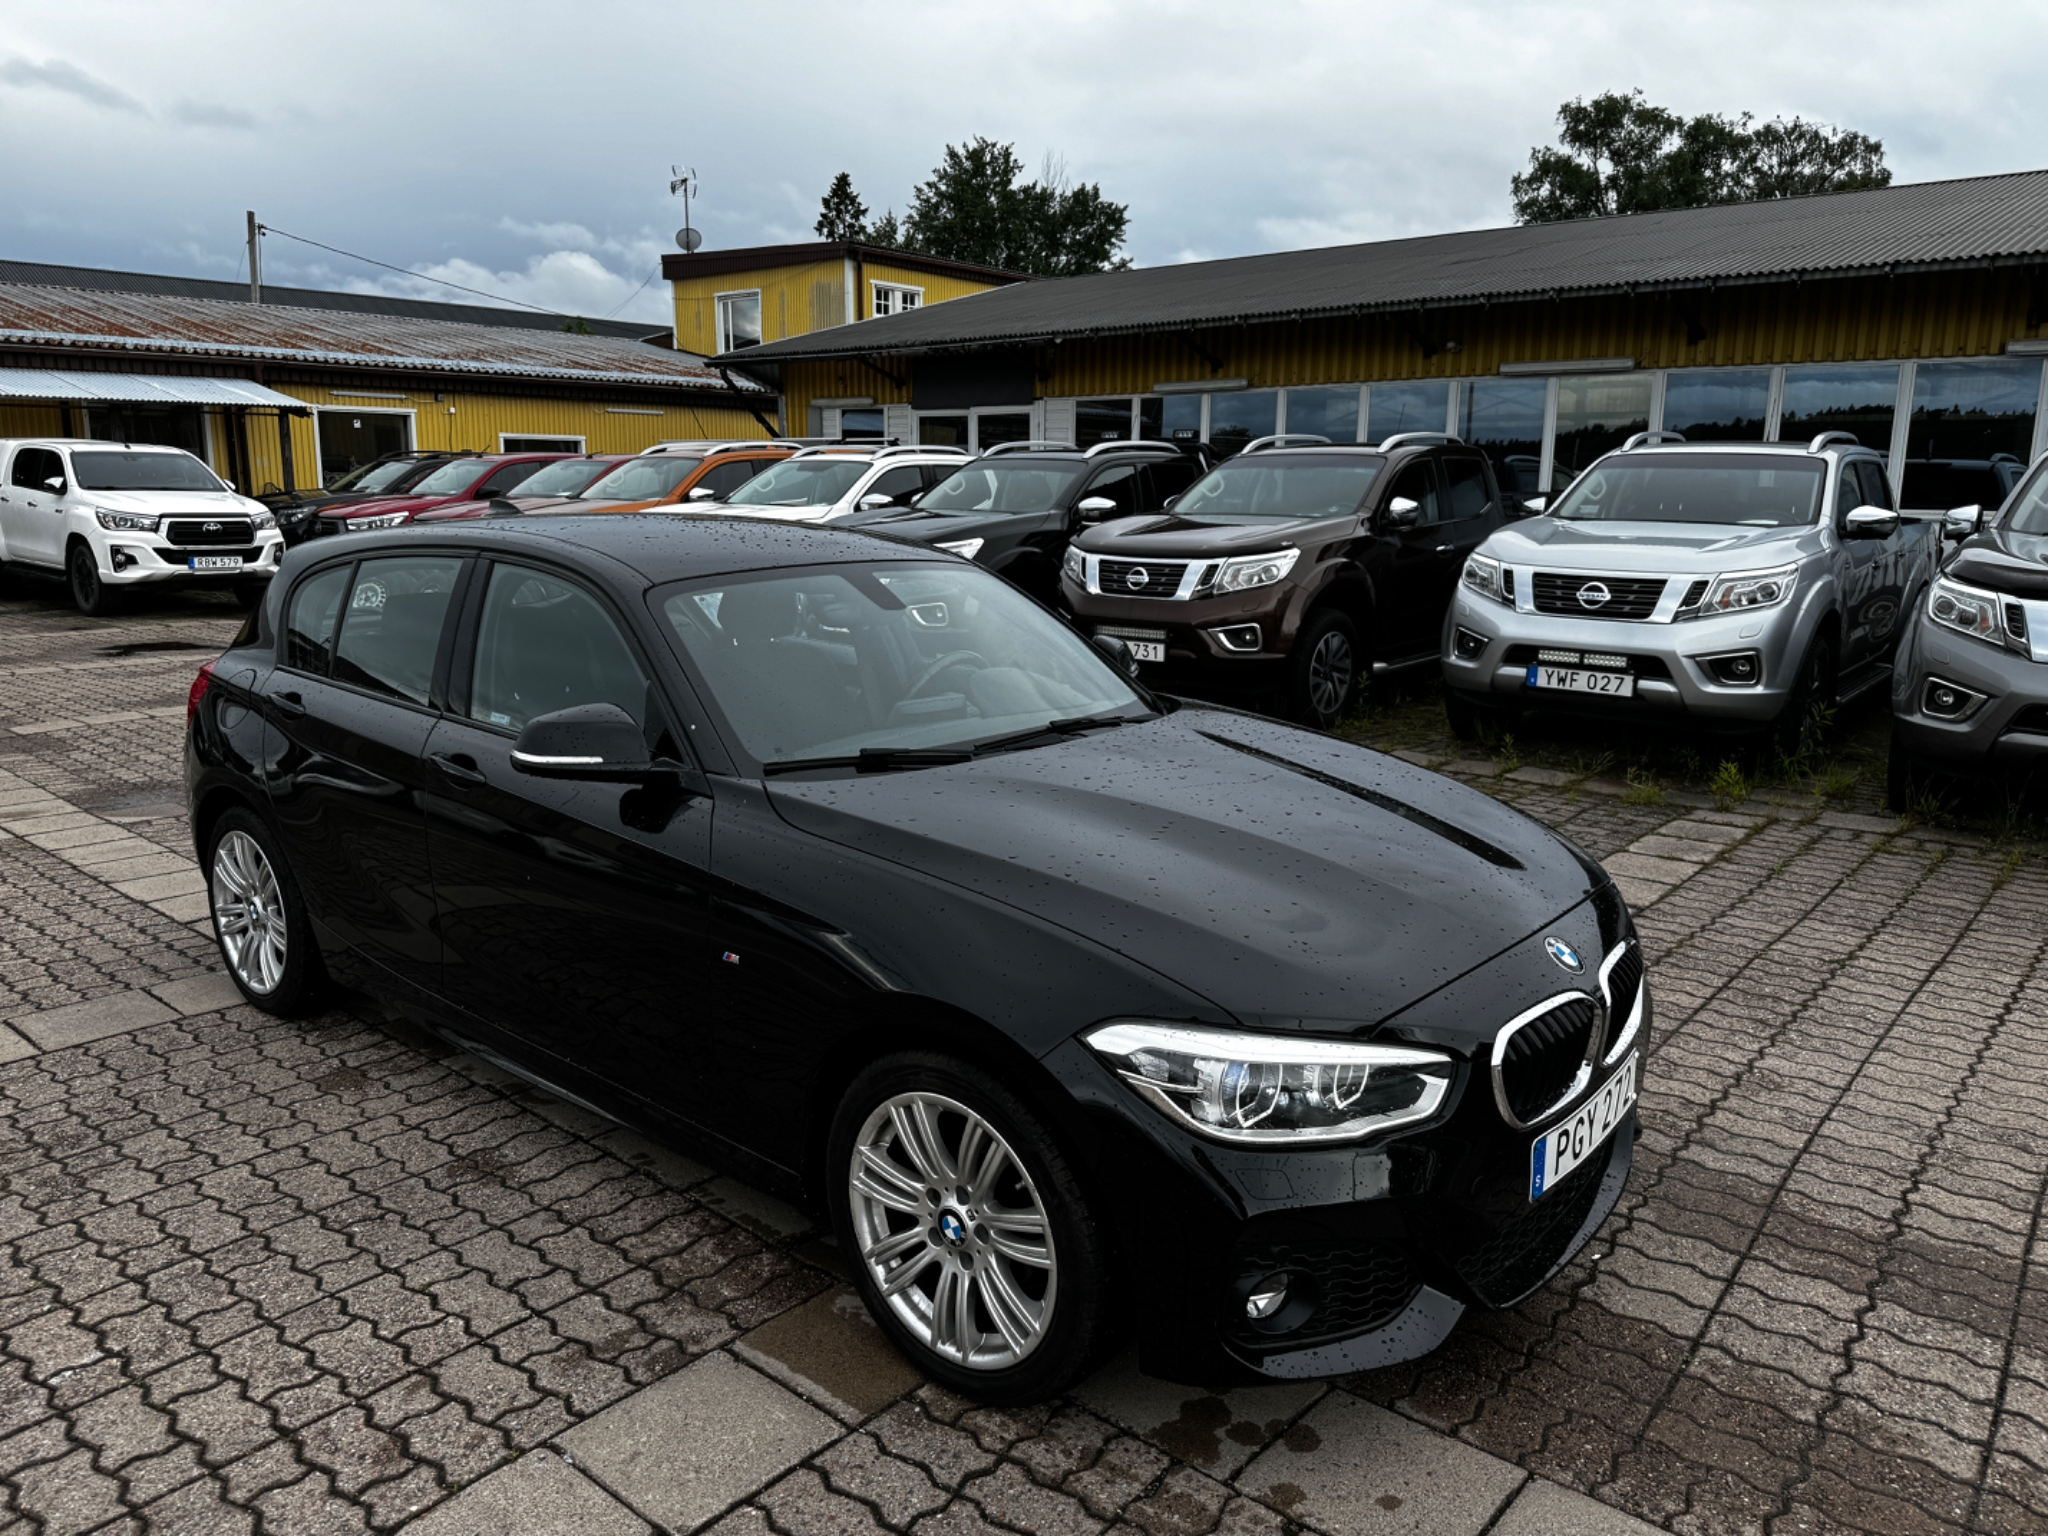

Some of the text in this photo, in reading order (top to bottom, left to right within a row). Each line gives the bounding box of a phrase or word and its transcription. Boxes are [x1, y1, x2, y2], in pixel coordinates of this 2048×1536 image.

[197, 557, 239, 567] RBW 579
[1133, 643, 1158, 660] 731
[1544, 669, 1625, 693] YWF 027
[1554, 1100, 1599, 1177] PGY
[1601, 1064, 1632, 1134] 272
